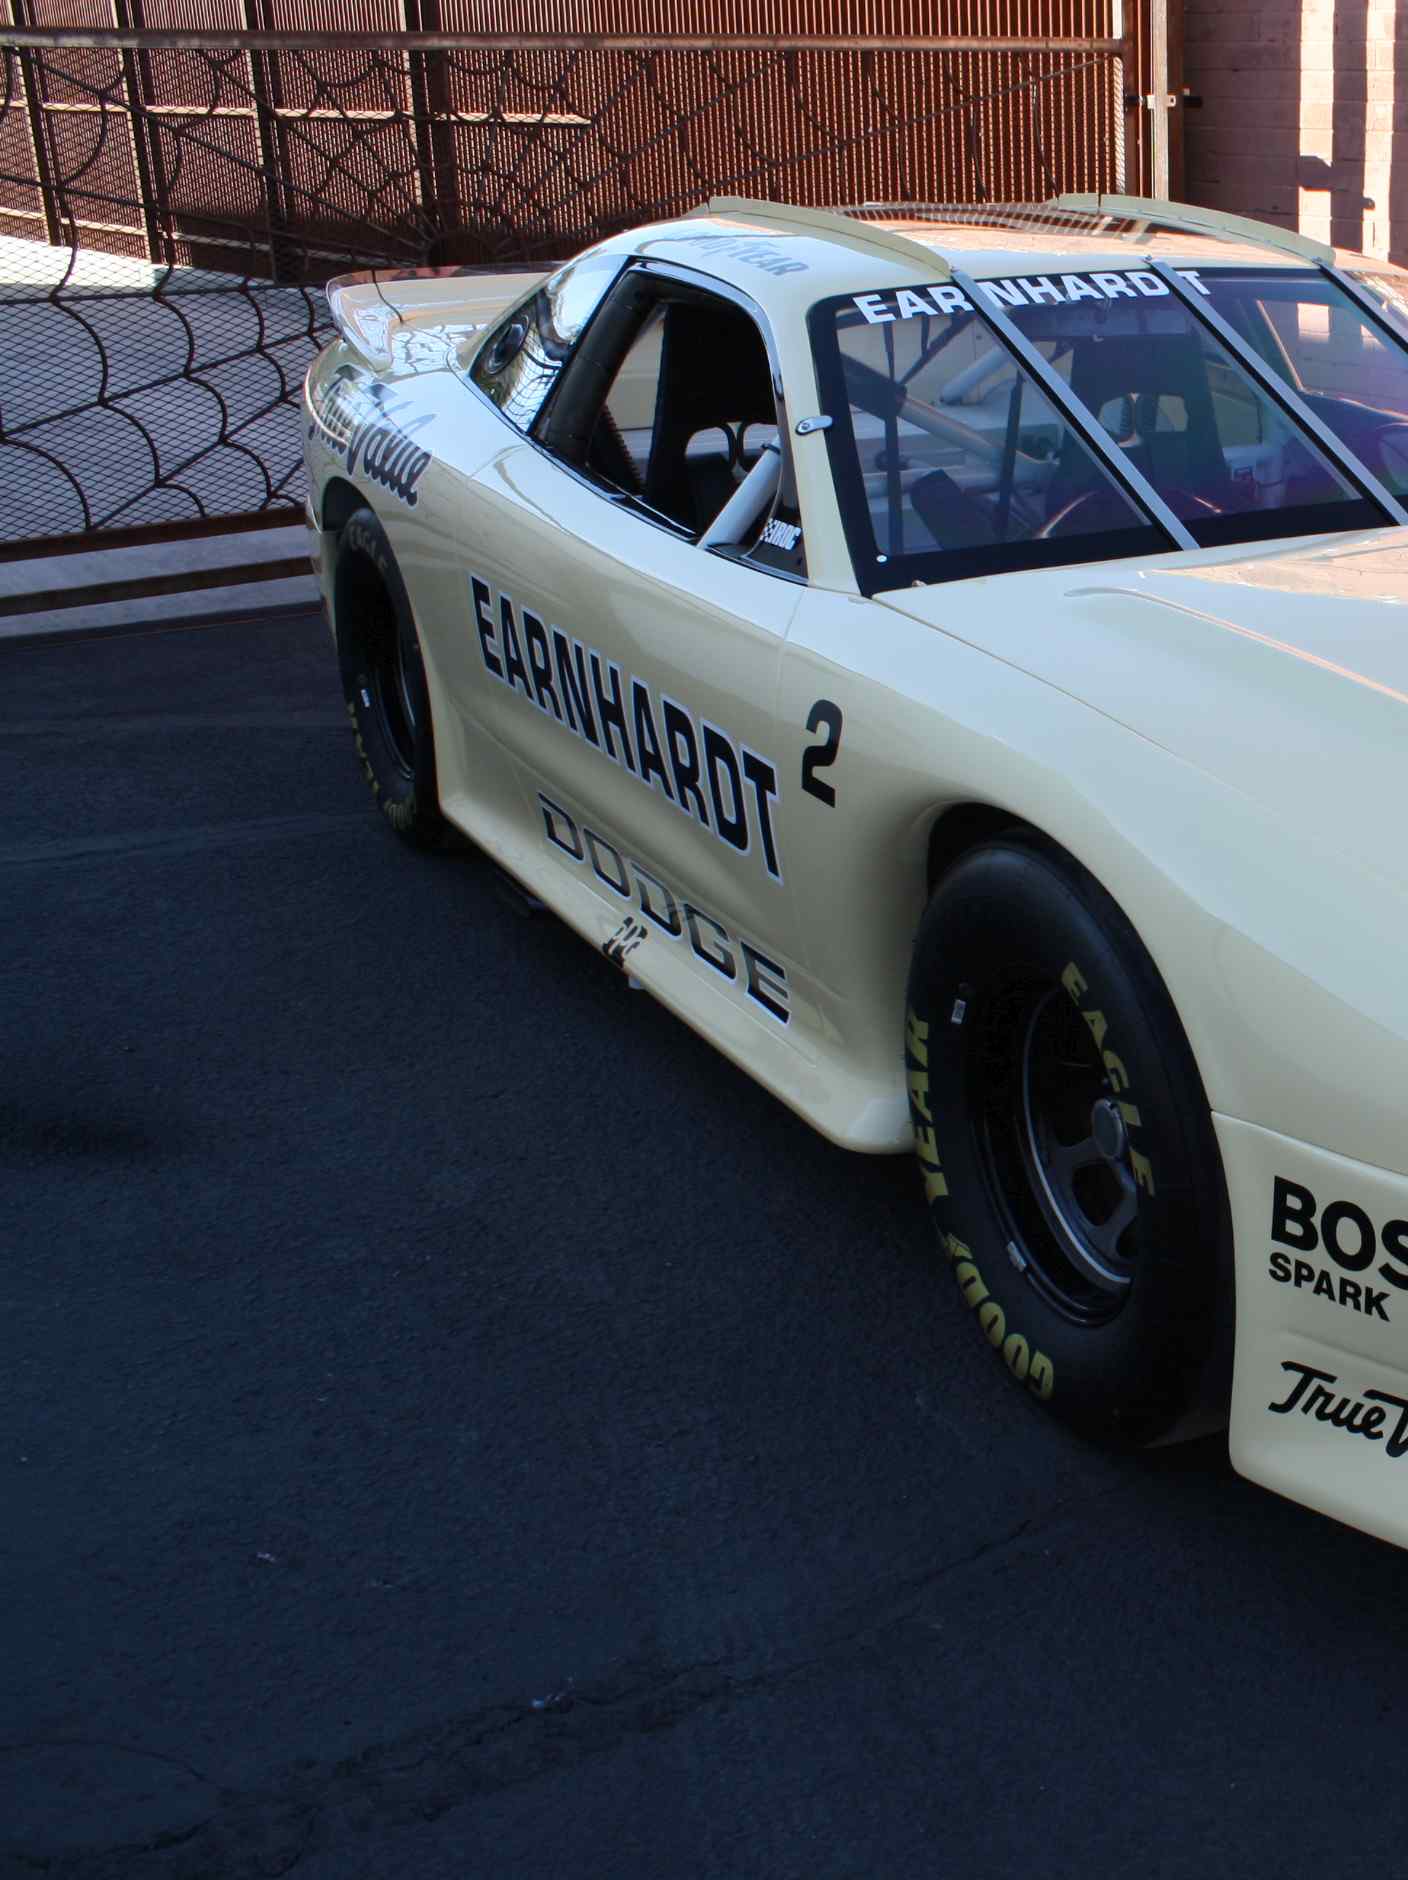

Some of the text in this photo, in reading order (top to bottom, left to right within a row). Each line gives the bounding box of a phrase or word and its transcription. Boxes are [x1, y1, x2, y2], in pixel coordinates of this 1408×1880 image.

[853, 269, 1211, 324] EARNHARDT
[468, 571, 784, 887] EARNHARDT
[802, 699, 844, 809] 2
[536, 791, 792, 1025] DODGE
[1268, 1251, 1391, 1323] SPARK
